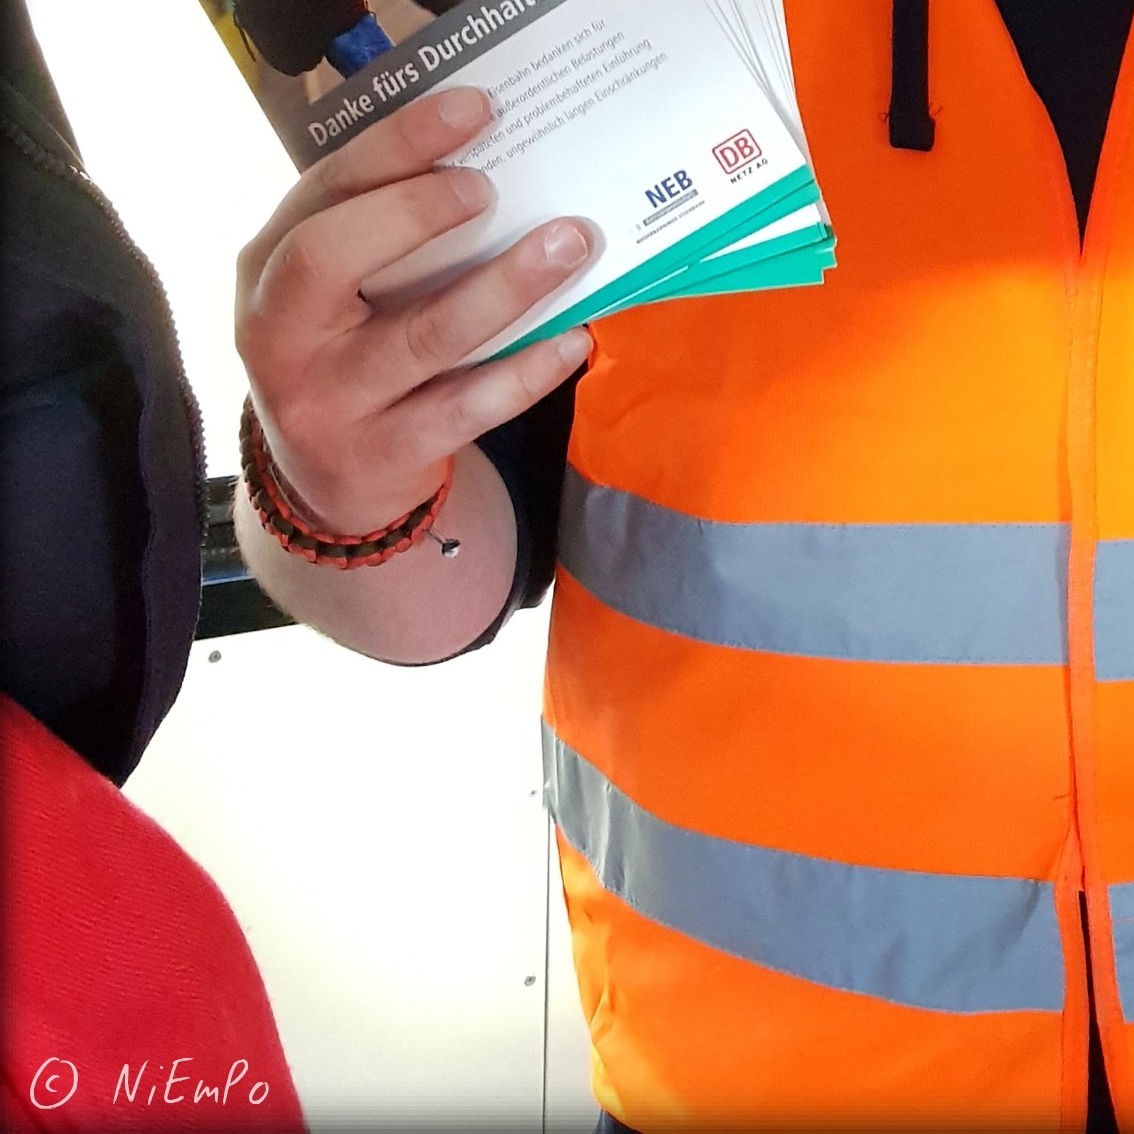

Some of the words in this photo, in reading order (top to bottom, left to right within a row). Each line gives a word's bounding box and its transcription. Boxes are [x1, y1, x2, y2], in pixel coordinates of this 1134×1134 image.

[486, 67, 532, 99] Eisenbahn
[531, 41, 574, 71] bedanken
[574, 29, 592, 45] sich
[591, 18, 606, 33] für
[496, 65, 572, 117] außerordentlichen
[571, 29, 625, 68] Belastungen
[505, 119, 523, 135] und
[523, 70, 603, 126] problembehafteten
[602, 38, 652, 72] Einführung
[306, 95, 375, 148] Danke
[372, 60, 420, 103] fürs
[480, 155, 506, 173] nden,
[506, 116, 565, 158] ungewöhnlich
[565, 97, 596, 123] langen
[595, 51, 668, 102] Einschränkungen
[645, 170, 692, 208] NEB
[719, 137, 754, 168] DB
[730, 166, 752, 184] NETZ
[756, 158, 768, 168] AG
